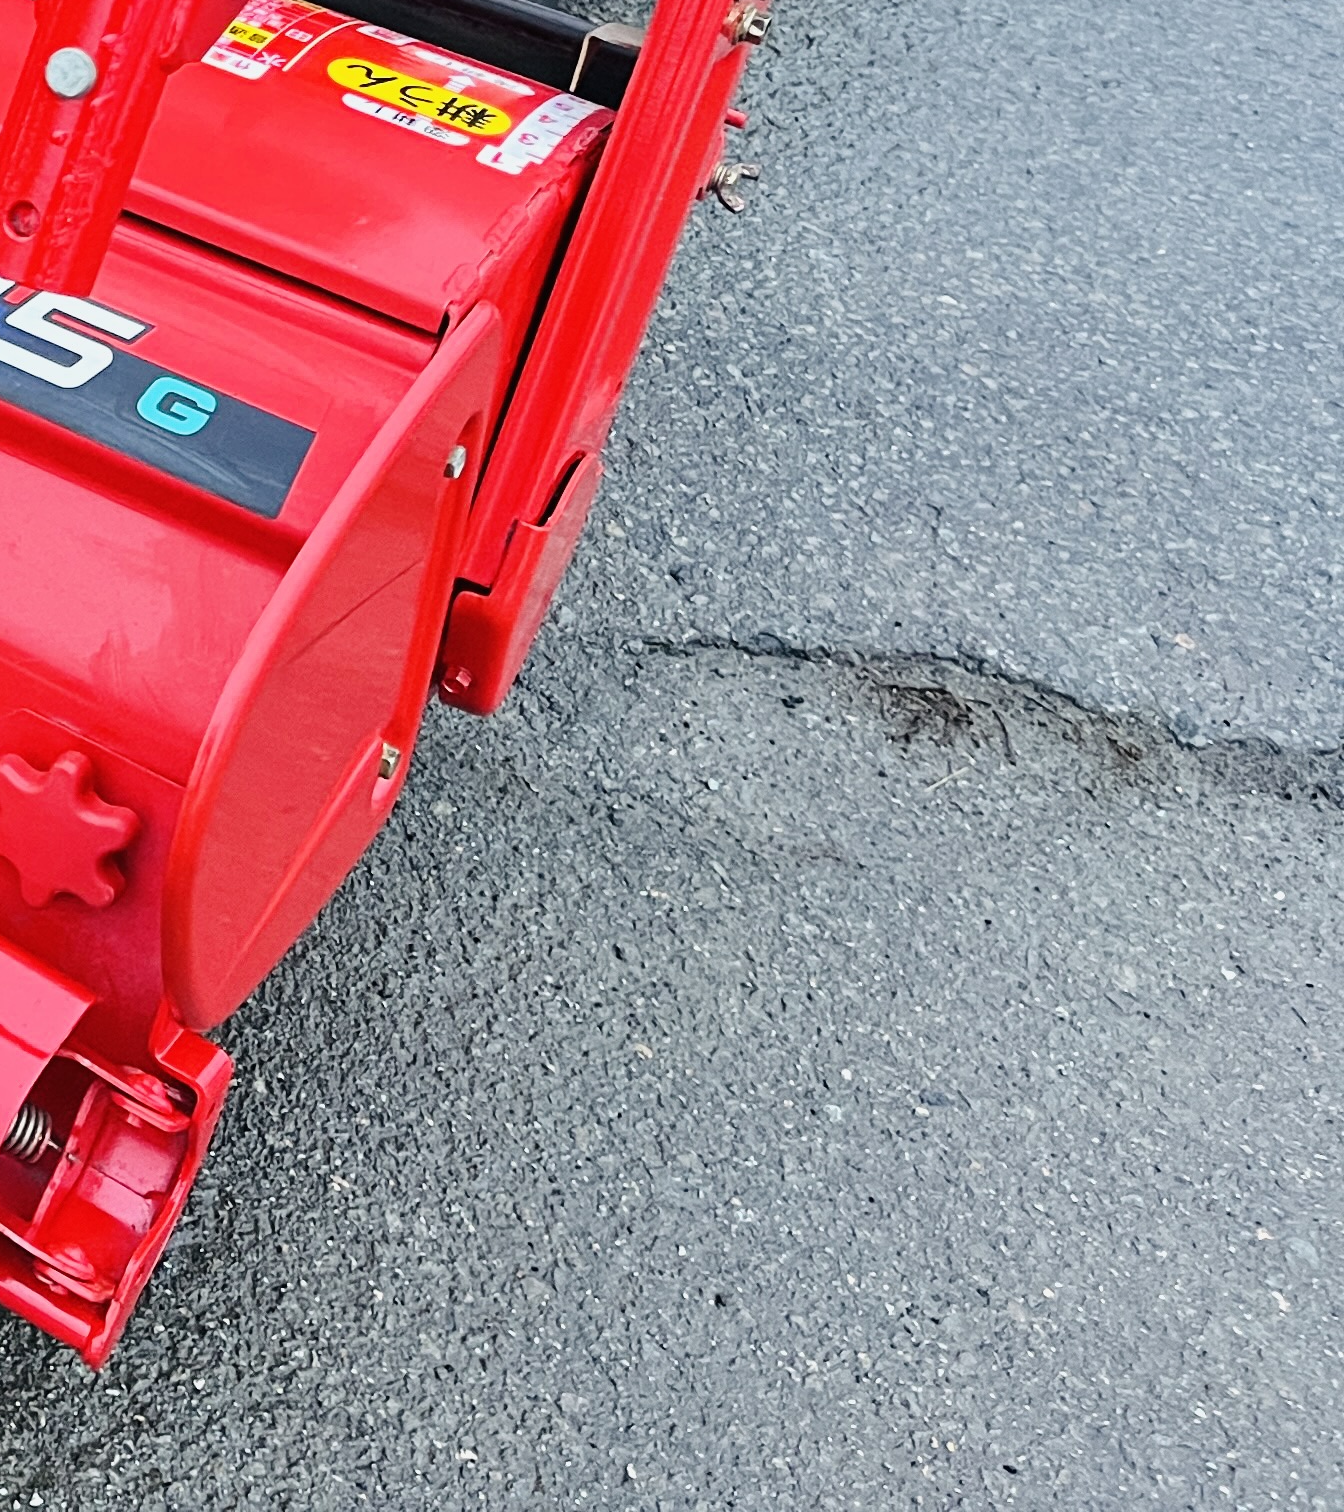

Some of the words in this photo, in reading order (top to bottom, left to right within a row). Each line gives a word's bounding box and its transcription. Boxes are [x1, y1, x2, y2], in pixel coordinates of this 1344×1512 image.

[346, 64, 497, 130] 耕うん
[517, 133, 539, 145] 3
[136, 375, 218, 436] G
